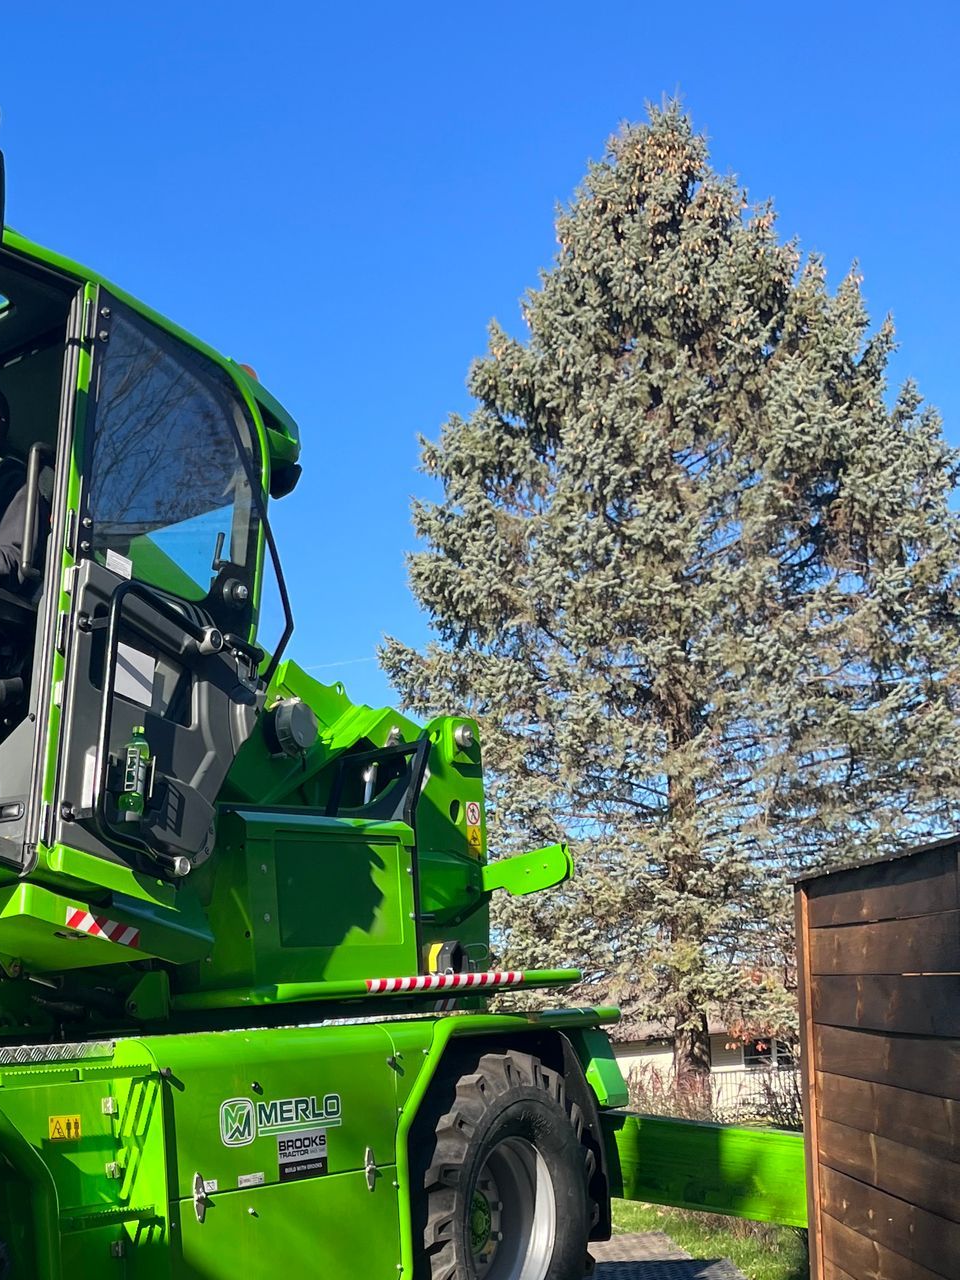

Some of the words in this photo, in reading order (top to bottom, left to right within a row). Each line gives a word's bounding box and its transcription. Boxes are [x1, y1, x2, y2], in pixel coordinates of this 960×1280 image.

[258, 1094, 341, 1126] MERLO
[278, 1135, 326, 1151] BROOKS
[279, 1149, 309, 1159] TRACTOR
